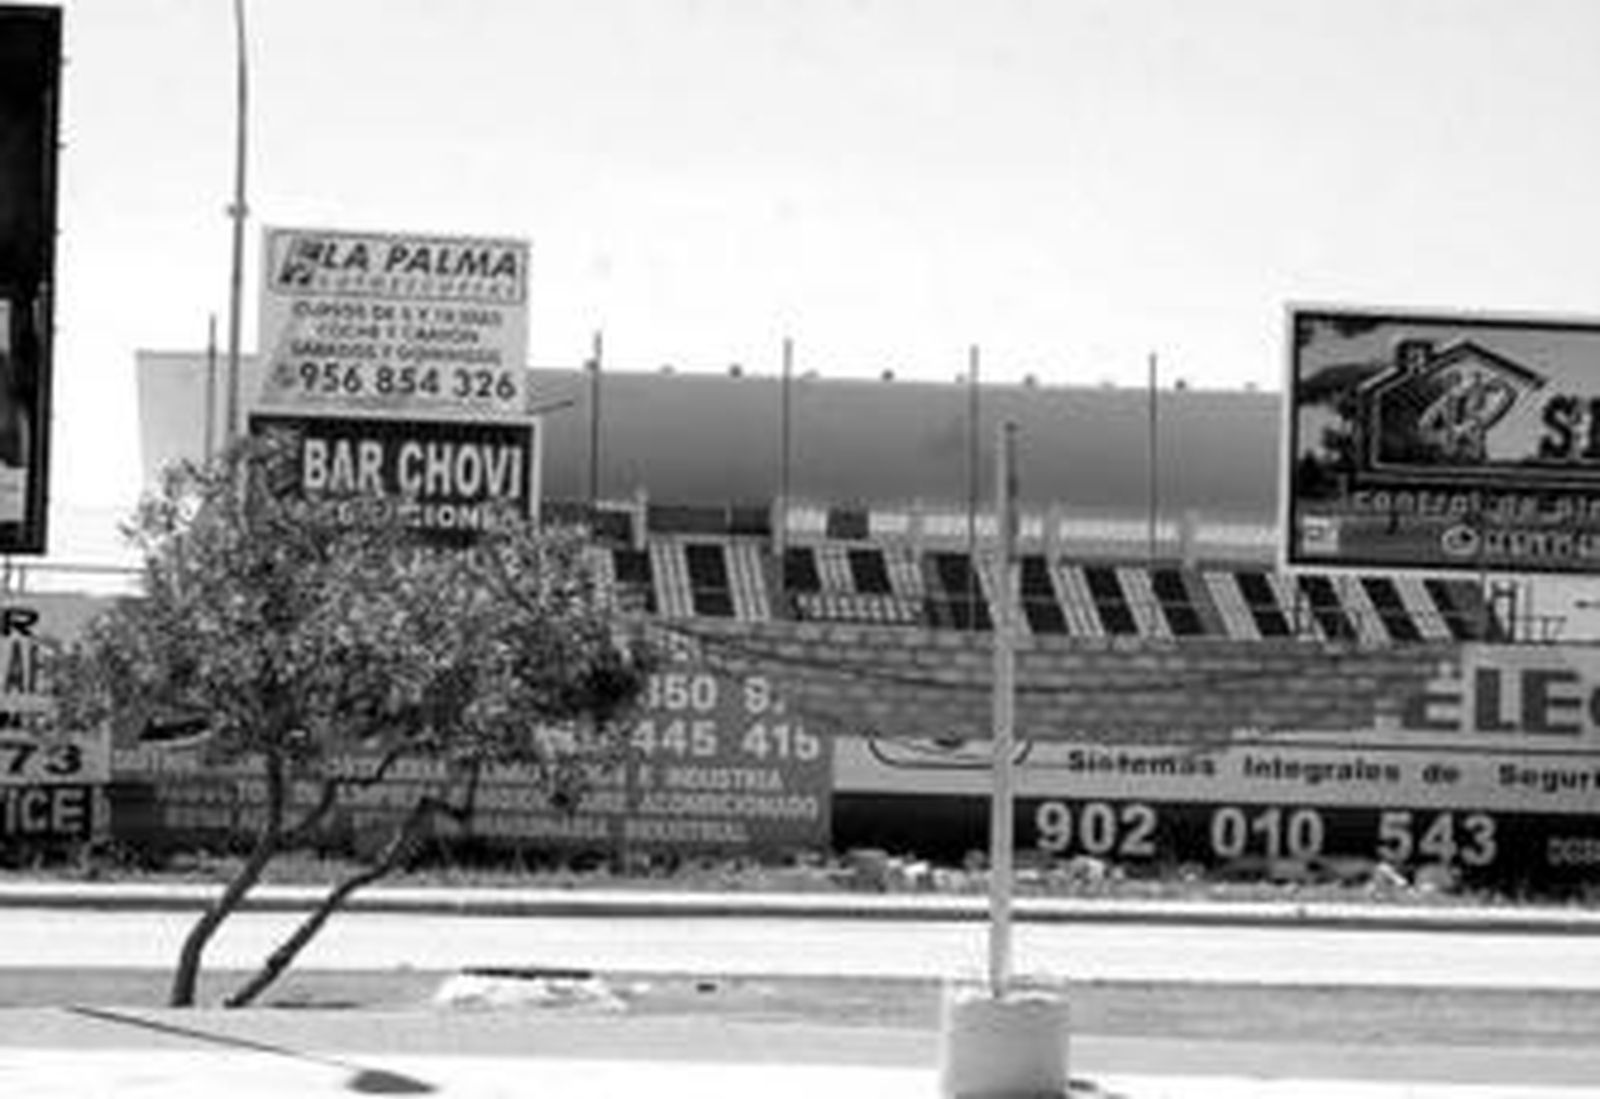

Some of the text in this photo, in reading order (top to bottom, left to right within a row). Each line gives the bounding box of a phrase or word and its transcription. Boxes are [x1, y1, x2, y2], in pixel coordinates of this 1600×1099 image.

[323, 242, 516, 278] LA PALMA
[300, 362, 516, 400] 956 854 326
[303, 439, 522, 498] BAR CHOVI
[1402, 667, 1600, 735] ELE
[629, 719, 718, 757] 445
[1068, 750, 1215, 777] Sistemas
[1244, 754, 1400, 784] Integrales
[1422, 764, 1459, 784] de
[1037, 803, 1156, 855] 902
[1211, 807, 1324, 858] 010
[1376, 811, 1497, 866] 543
